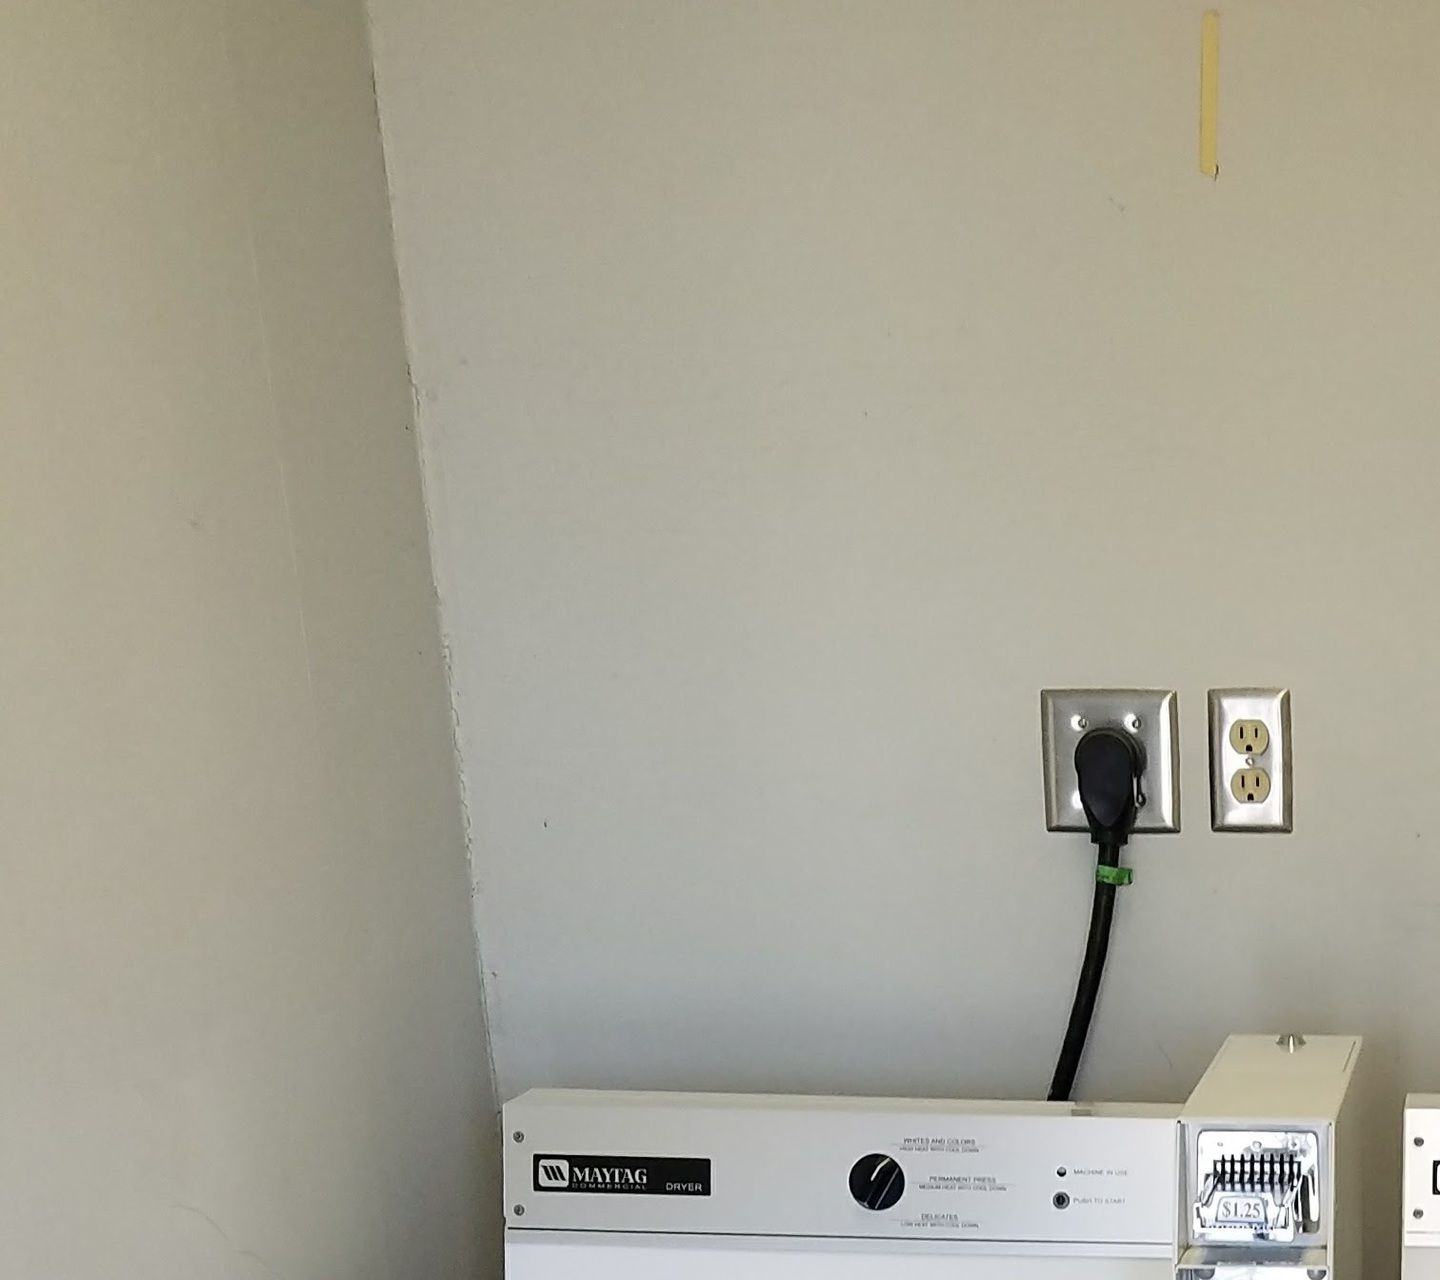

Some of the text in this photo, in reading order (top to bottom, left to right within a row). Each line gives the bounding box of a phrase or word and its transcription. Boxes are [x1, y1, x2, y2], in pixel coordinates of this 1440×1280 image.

[573, 1167, 647, 1184] MAYTAG
[1074, 1168, 1104, 1176] MACHINE
[929, 1176, 972, 1184] PERMANENT
[572, 1182, 703, 1192] COMMERCIAL DRYER
[1222, 1202, 1261, 1219] $1.25
[921, 1213, 959, 1221] DELICATES
